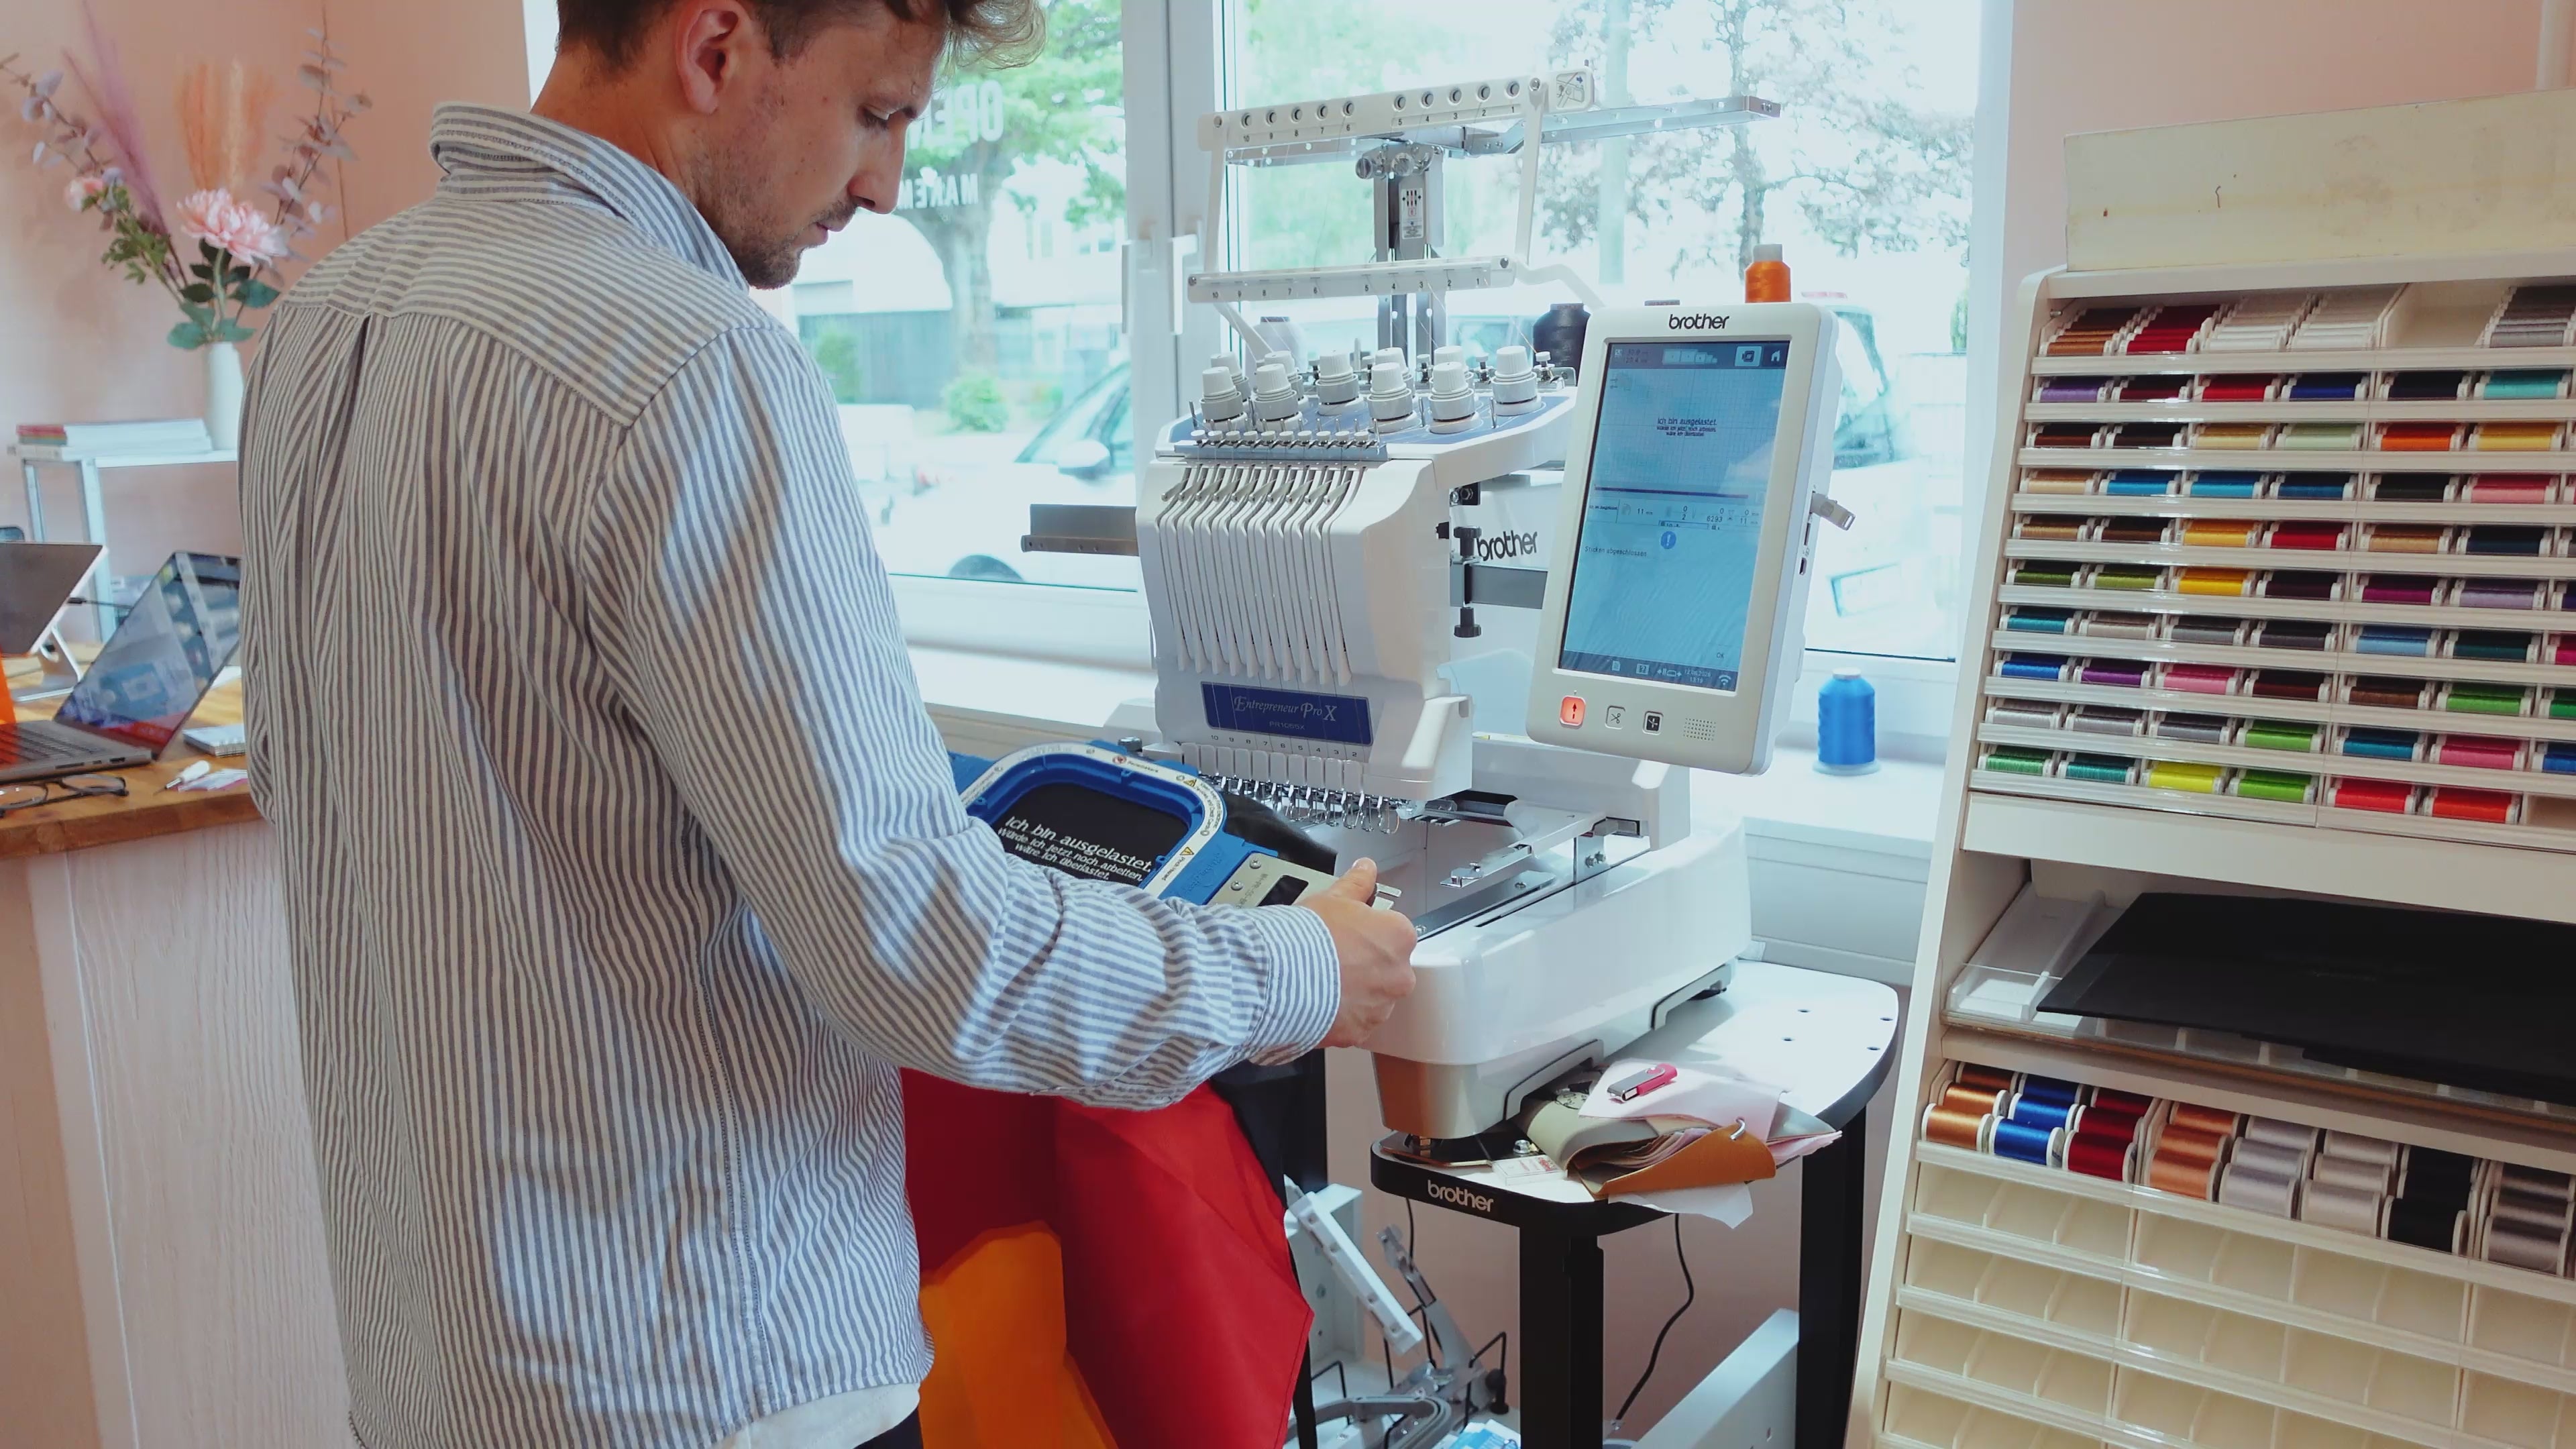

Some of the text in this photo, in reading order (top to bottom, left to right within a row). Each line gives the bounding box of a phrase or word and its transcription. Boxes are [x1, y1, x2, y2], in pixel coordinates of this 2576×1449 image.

[1243, 135, 1250, 143] 10
[1669, 314, 1729, 329] brother
[1477, 530, 1538, 561] brother
[1234, 696, 1338, 721] Entrepreneur Pro X
[998, 827, 1028, 843] Würde
[1073, 853, 1098, 867] noch
[1006, 816, 1152, 872] Ich bin ausgelastet.
[1428, 1179, 1493, 1212] brother
